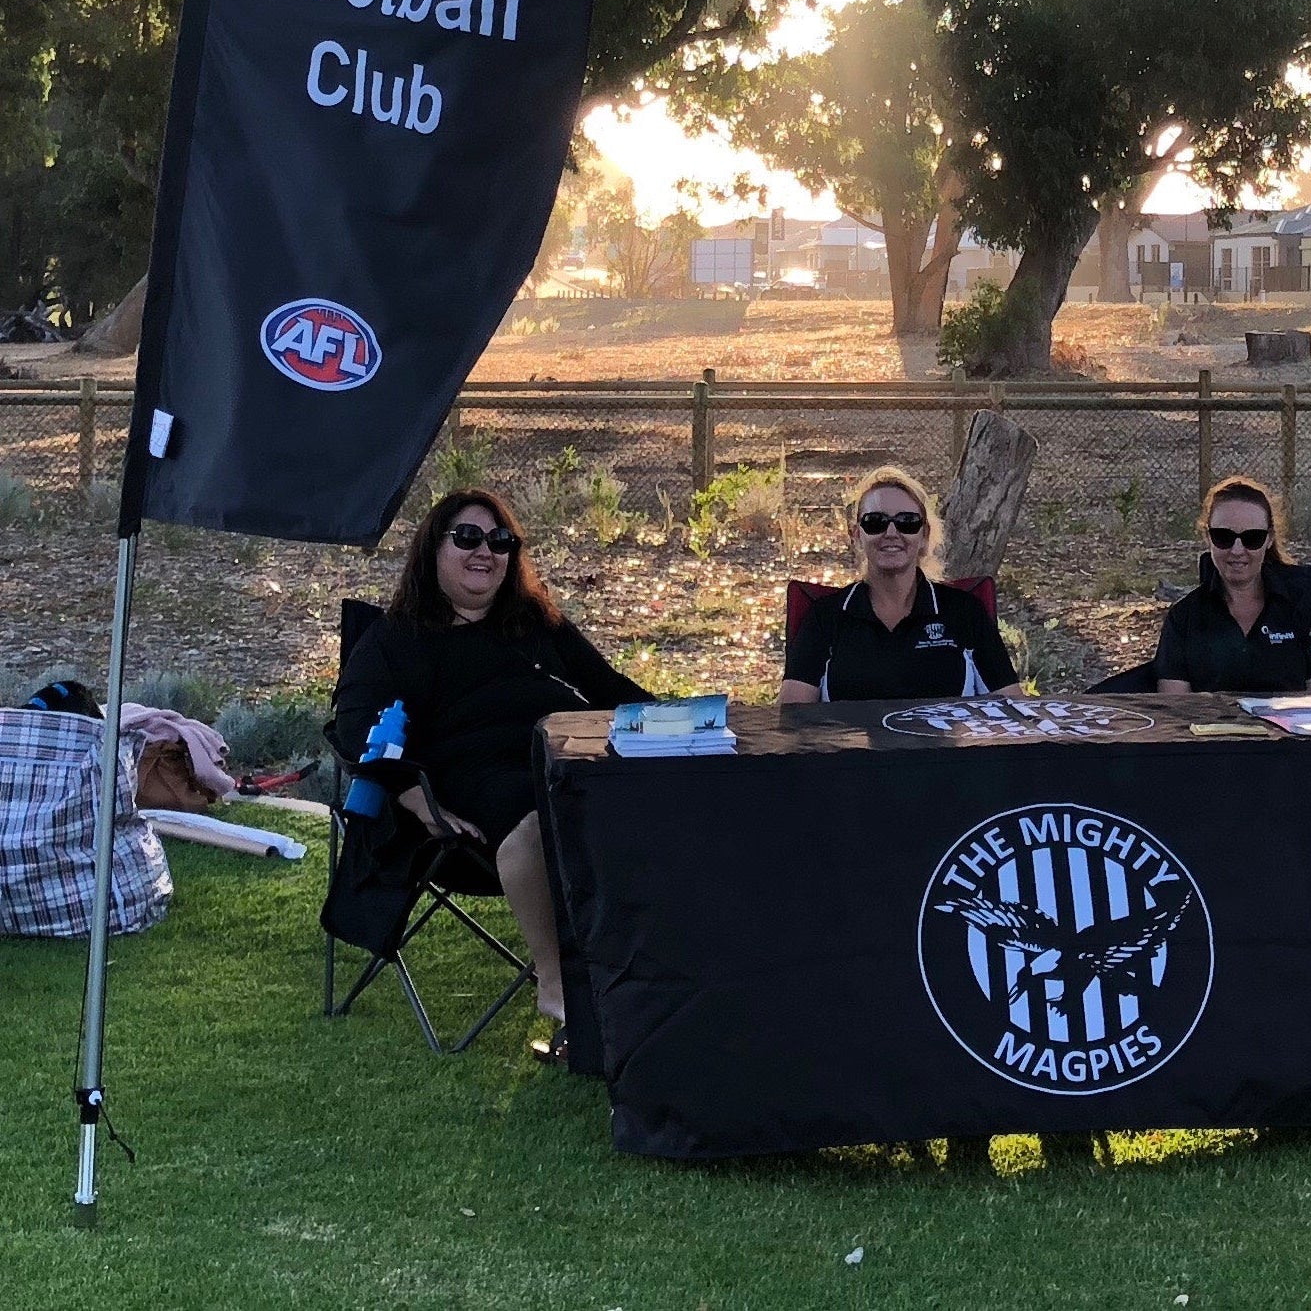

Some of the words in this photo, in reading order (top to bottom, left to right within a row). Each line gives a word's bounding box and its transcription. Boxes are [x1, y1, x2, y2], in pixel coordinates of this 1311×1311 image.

[306, 39, 443, 135] Club
[270, 316, 367, 377] AFL
[942, 826, 1015, 892] THE
[1018, 812, 1180, 887] MIGHTY
[993, 1025, 1162, 1083] MAGPIES
